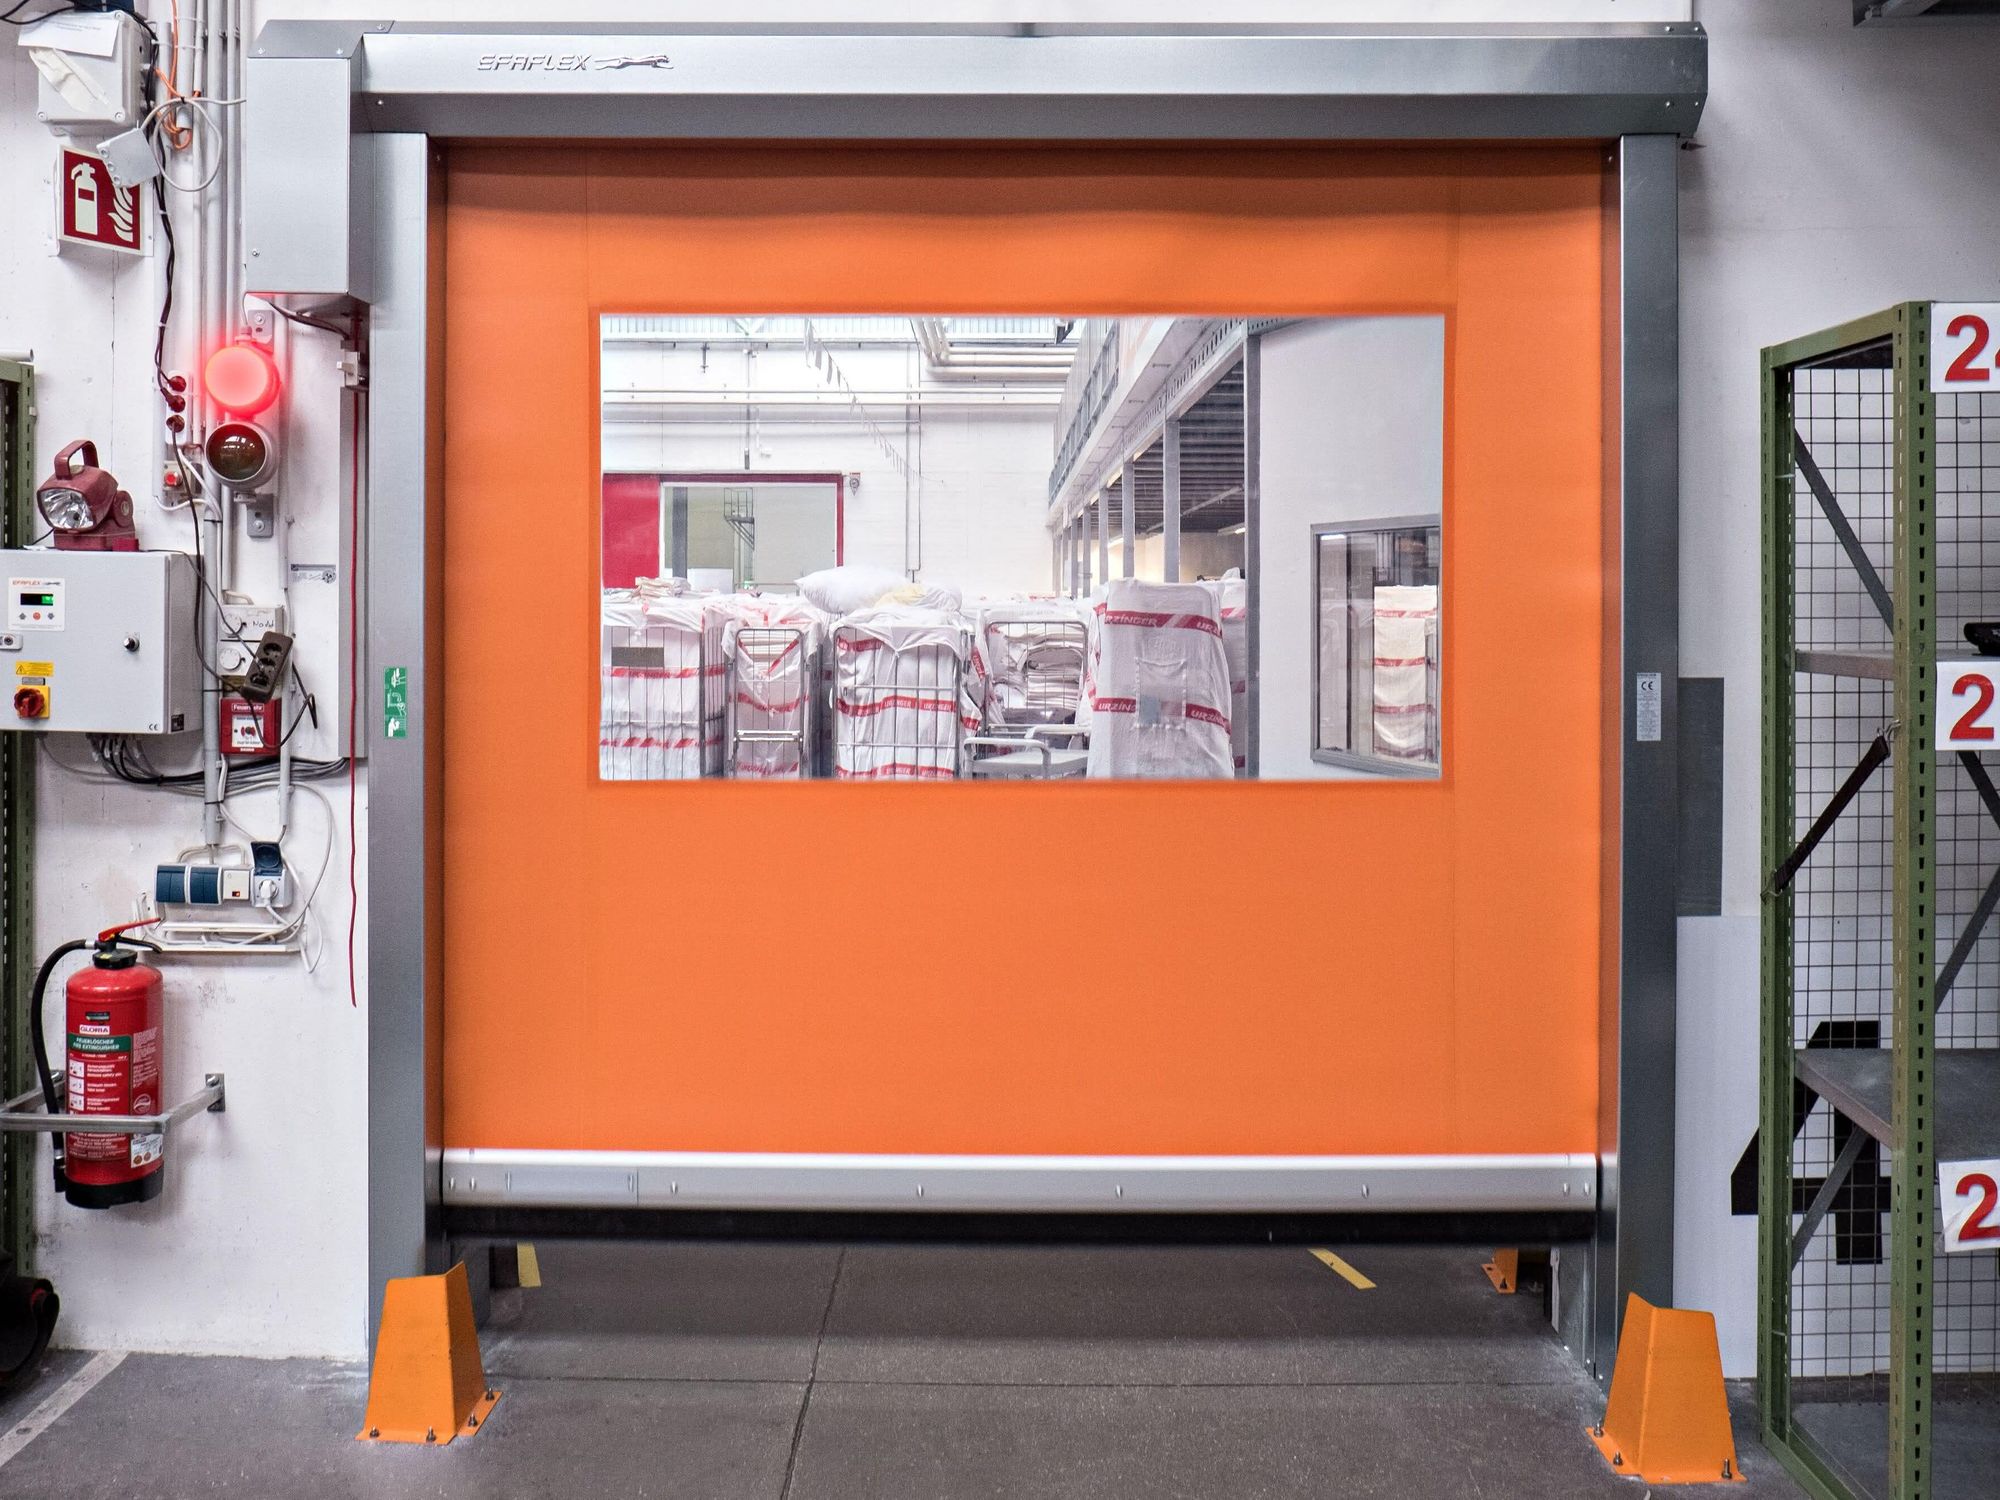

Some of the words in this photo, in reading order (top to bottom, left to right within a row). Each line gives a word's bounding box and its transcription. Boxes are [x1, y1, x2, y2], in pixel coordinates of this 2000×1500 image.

[477, 54, 592, 71] EFAFLEX
[1945, 314, 2000, 382] 2
[1950, 673, 1994, 740] 2
[1956, 1173, 2000, 1242] 2
